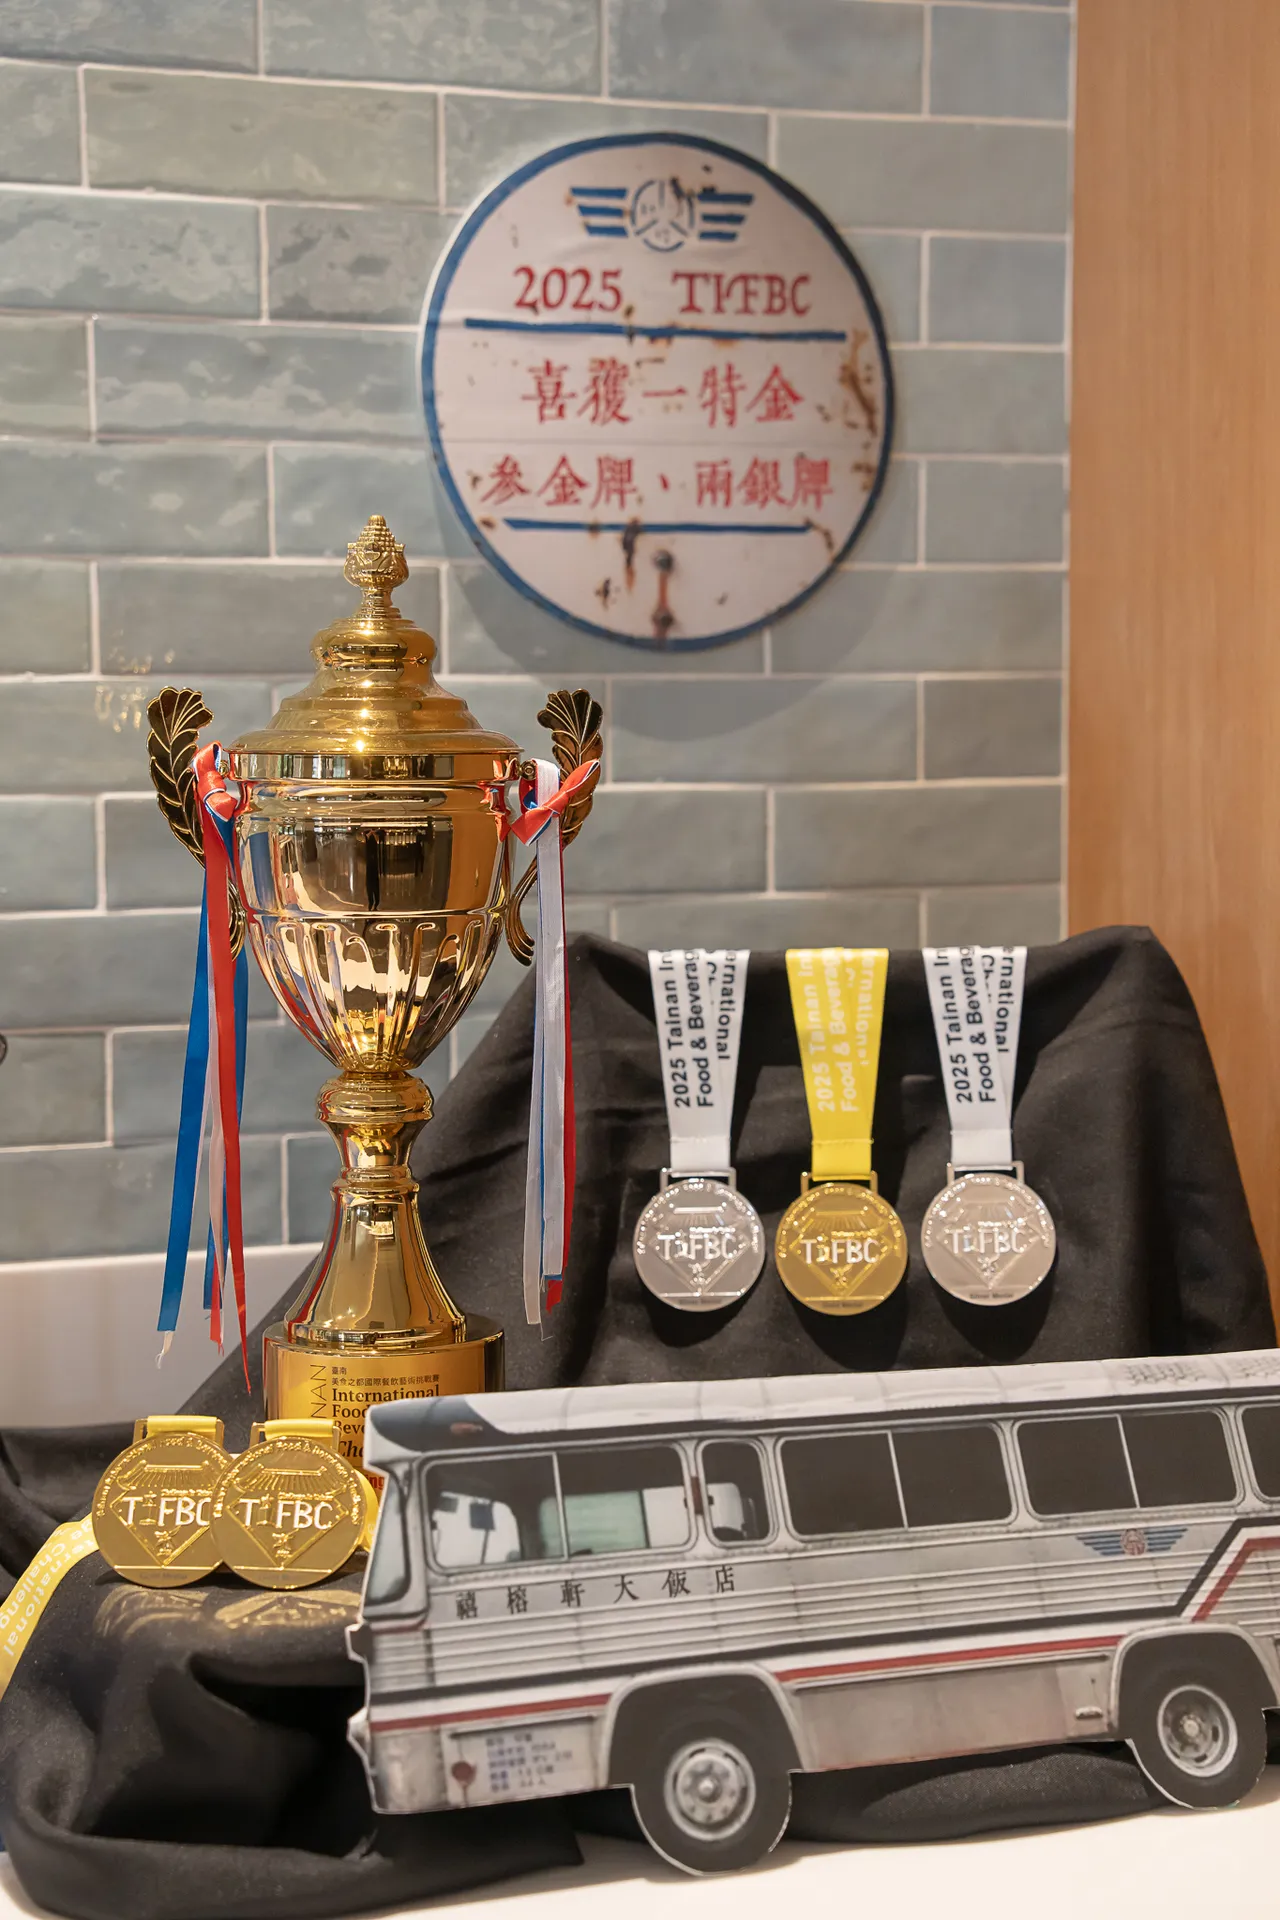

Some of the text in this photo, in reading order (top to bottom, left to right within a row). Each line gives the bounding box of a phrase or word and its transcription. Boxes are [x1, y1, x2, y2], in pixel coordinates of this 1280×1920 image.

[514, 266, 622, 309] 2025
[521, 359, 804, 429] 喜獲一特金
[664, 980, 683, 1050] Tainan
[940, 976, 962, 1046] Tainan
[690, 1036, 707, 1050] &
[970, 1031, 986, 1045] &
[670, 1058, 690, 1108] 2025
[693, 1058, 713, 1107] Food
[812, 1062, 835, 1112] 2025
[835, 1062, 859, 1112] Food
[951, 1053, 972, 1103] 2025
[973, 1052, 996, 1102] Food
[332, 1384, 440, 1402] International
